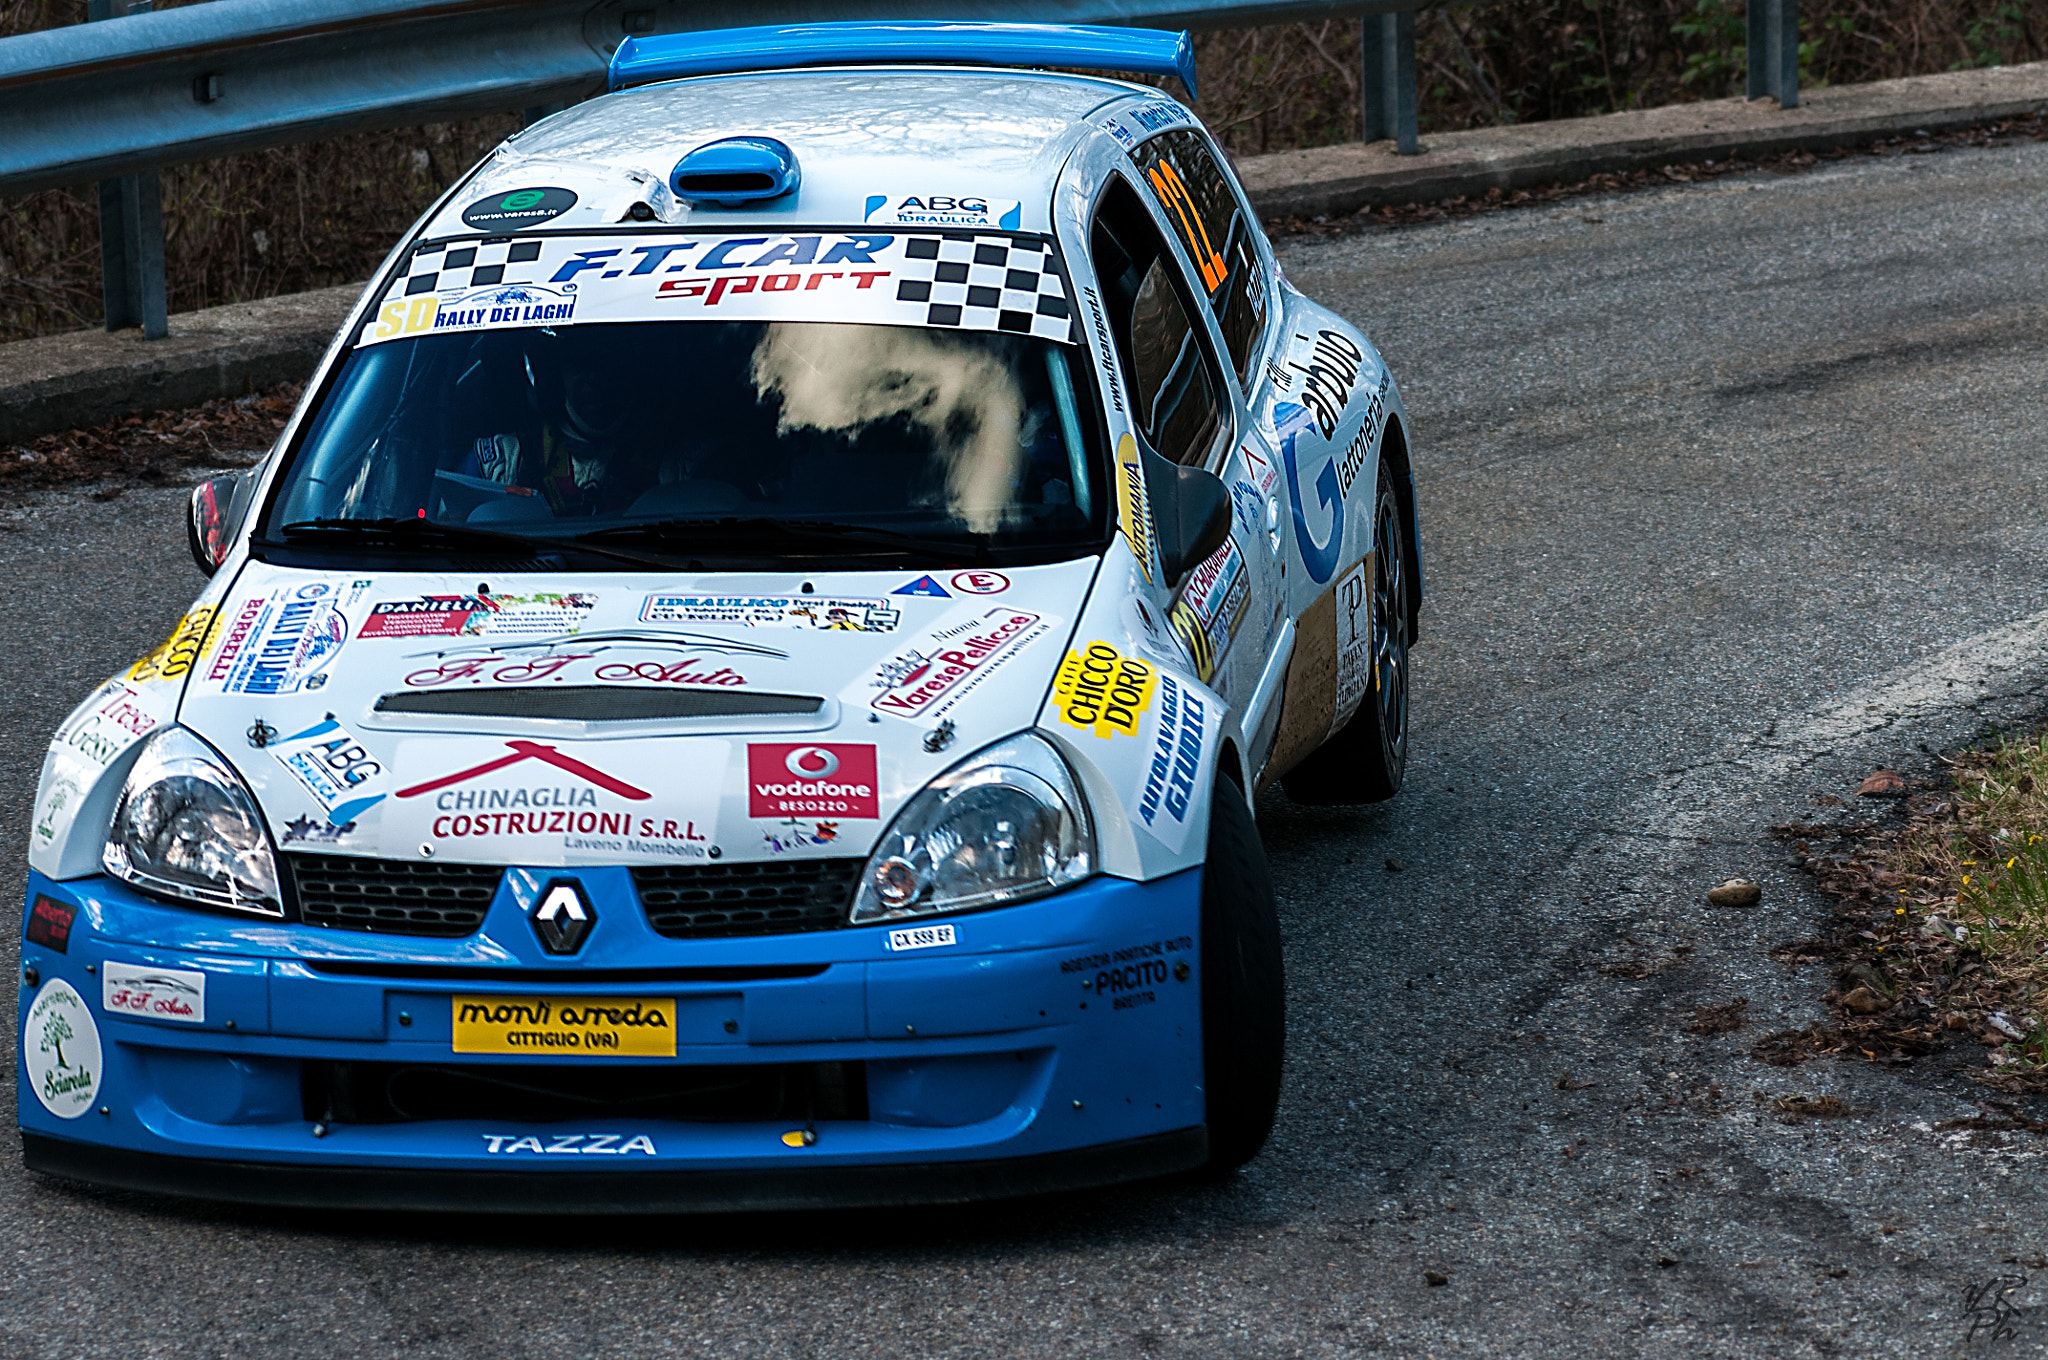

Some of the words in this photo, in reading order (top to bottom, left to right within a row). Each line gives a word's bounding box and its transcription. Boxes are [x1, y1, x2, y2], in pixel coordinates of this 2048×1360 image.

[898, 196, 988, 211] ABG
[376, 297, 438, 338] SD
[434, 307, 487, 328] RALLY
[489, 306, 520, 323] DEI
[523, 302, 576, 320] LAGHI
[1336, 392, 1384, 499] lattoneria
[208, 598, 266, 682] BORRELLI
[1067, 645, 1118, 725] CHICCO
[311, 737, 381, 789] ABG
[1139, 674, 1178, 828] AUTOLAVAGGIO
[1164, 688, 1204, 824] GIUDICI
[436, 788, 597, 810] CHINAGLIA
[755, 780, 871, 797] vodafone
[432, 812, 631, 838] COSTRUZIONI
[640, 819, 706, 841] S.R.L.
[564, 836, 622, 851] Laveno
[628, 840, 705, 857] Mombello
[1096, 958, 1168, 996] PACITO
[458, 1001, 551, 1024] monti
[507, 1031, 580, 1047] CITTIGLIO
[482, 1134, 657, 1156] TAZZA
